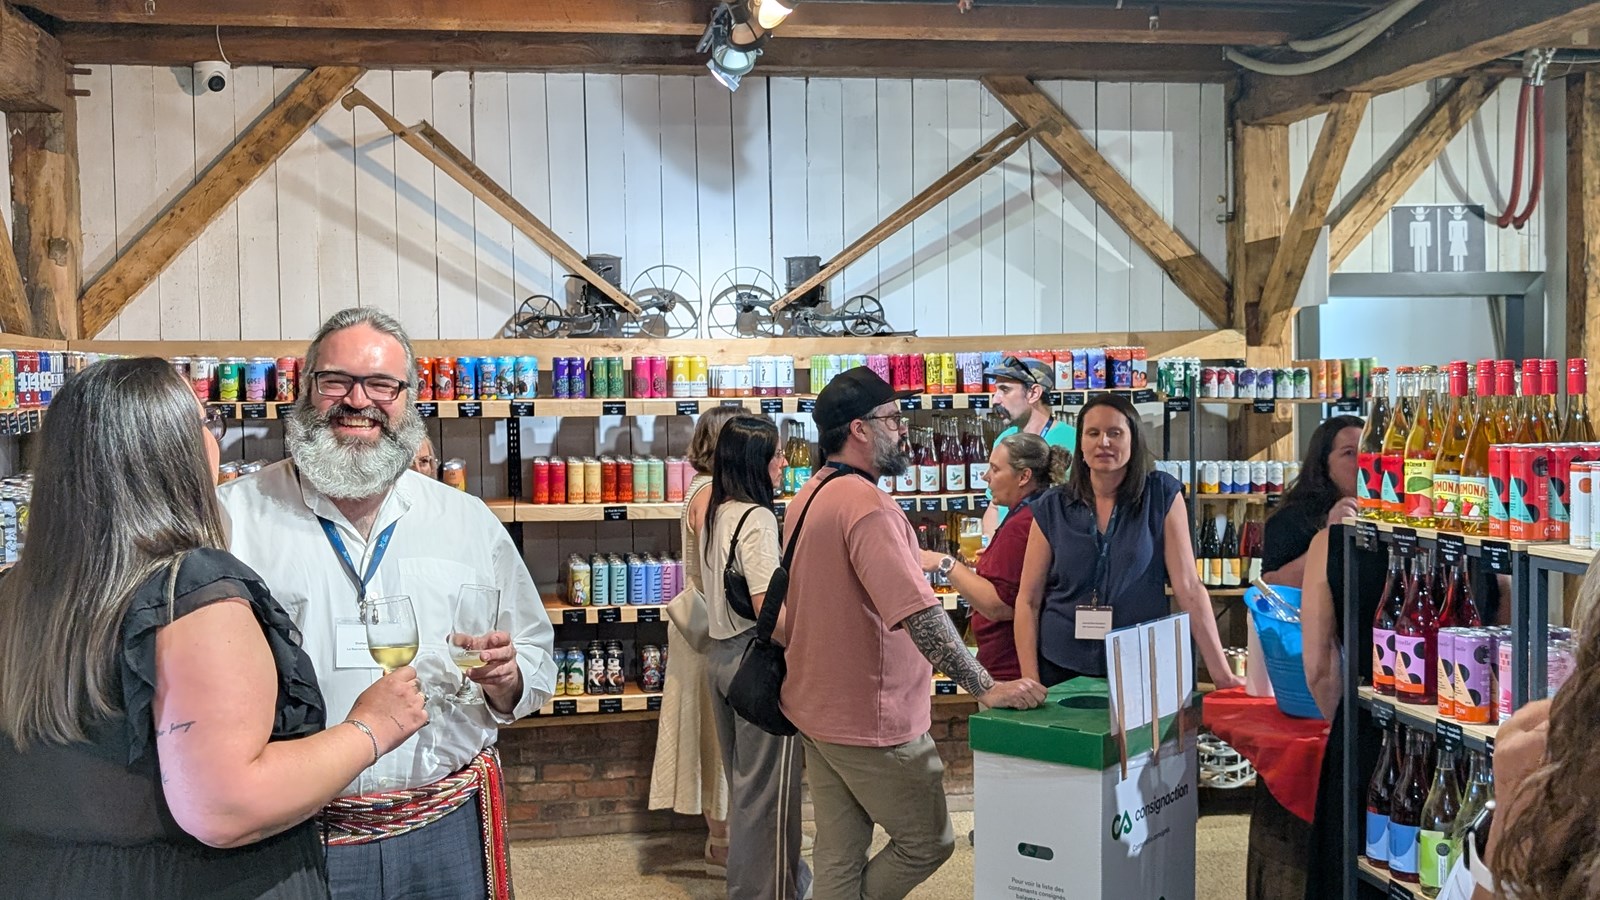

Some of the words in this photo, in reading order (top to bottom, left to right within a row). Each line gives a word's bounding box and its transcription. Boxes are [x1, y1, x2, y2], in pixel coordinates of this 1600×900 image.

[594, 567, 603, 604] intrus
[614, 567, 625, 604] intrus
[632, 567, 643, 604] intrus
[651, 566, 661, 603] intrus
[1135, 783, 1189, 821] consignaction
[1007, 885, 1038, 896] contenants
[1011, 876, 1024, 885] Pour
[1035, 881, 1041, 889] la
[1041, 882, 1054, 892] liste
[1054, 885, 1065, 894] des
